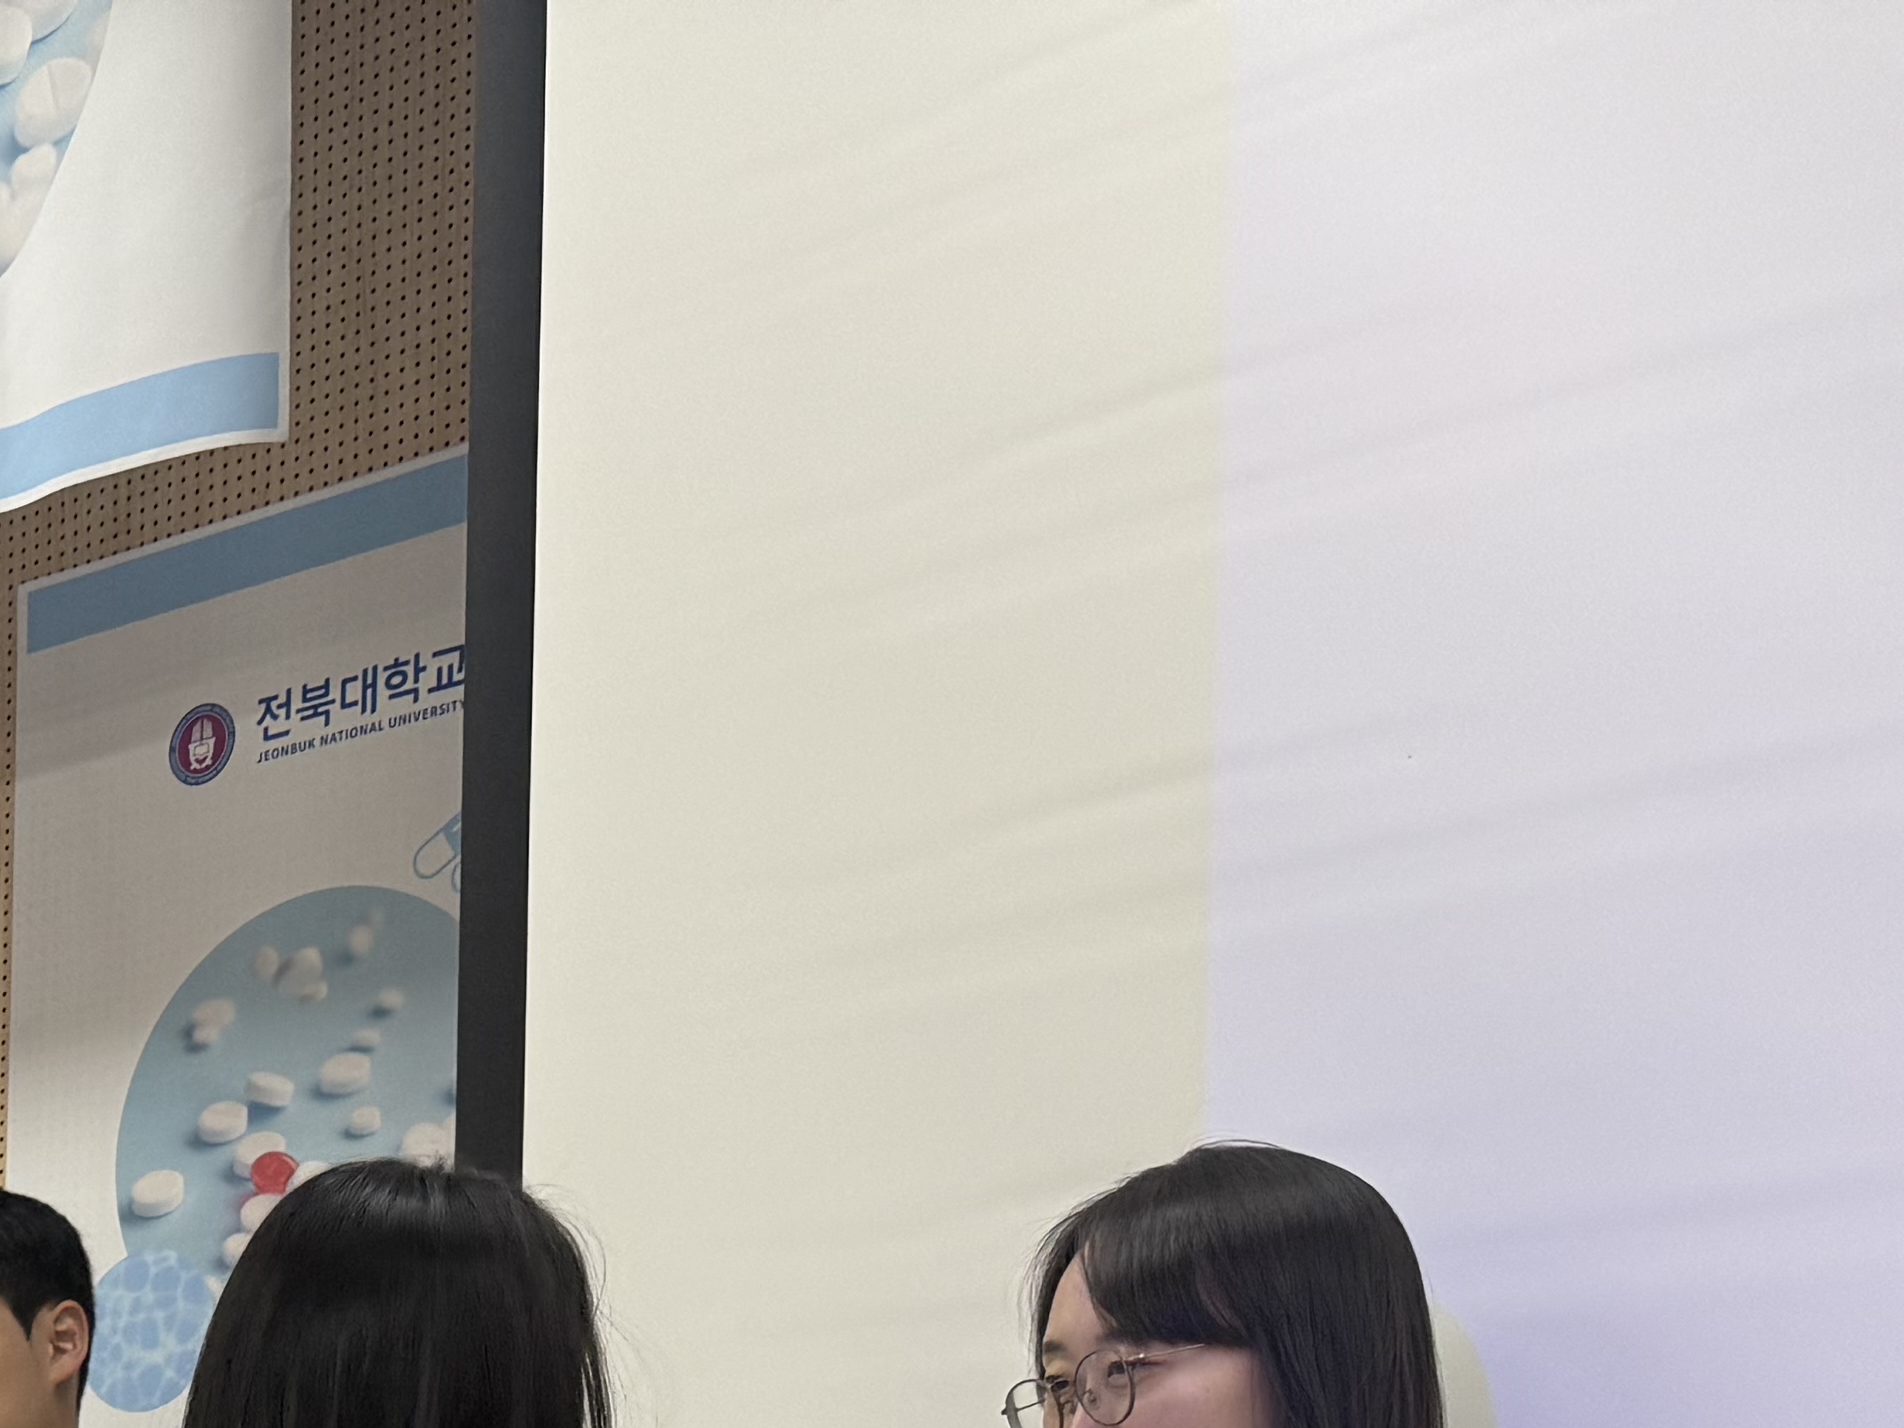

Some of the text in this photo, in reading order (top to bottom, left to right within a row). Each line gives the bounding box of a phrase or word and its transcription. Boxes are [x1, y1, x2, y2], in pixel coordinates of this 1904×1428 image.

[256, 644, 465, 742] 전북대학교
[257, 737, 317, 764] JEONBUK
[319, 719, 385, 748] NATIONAL
